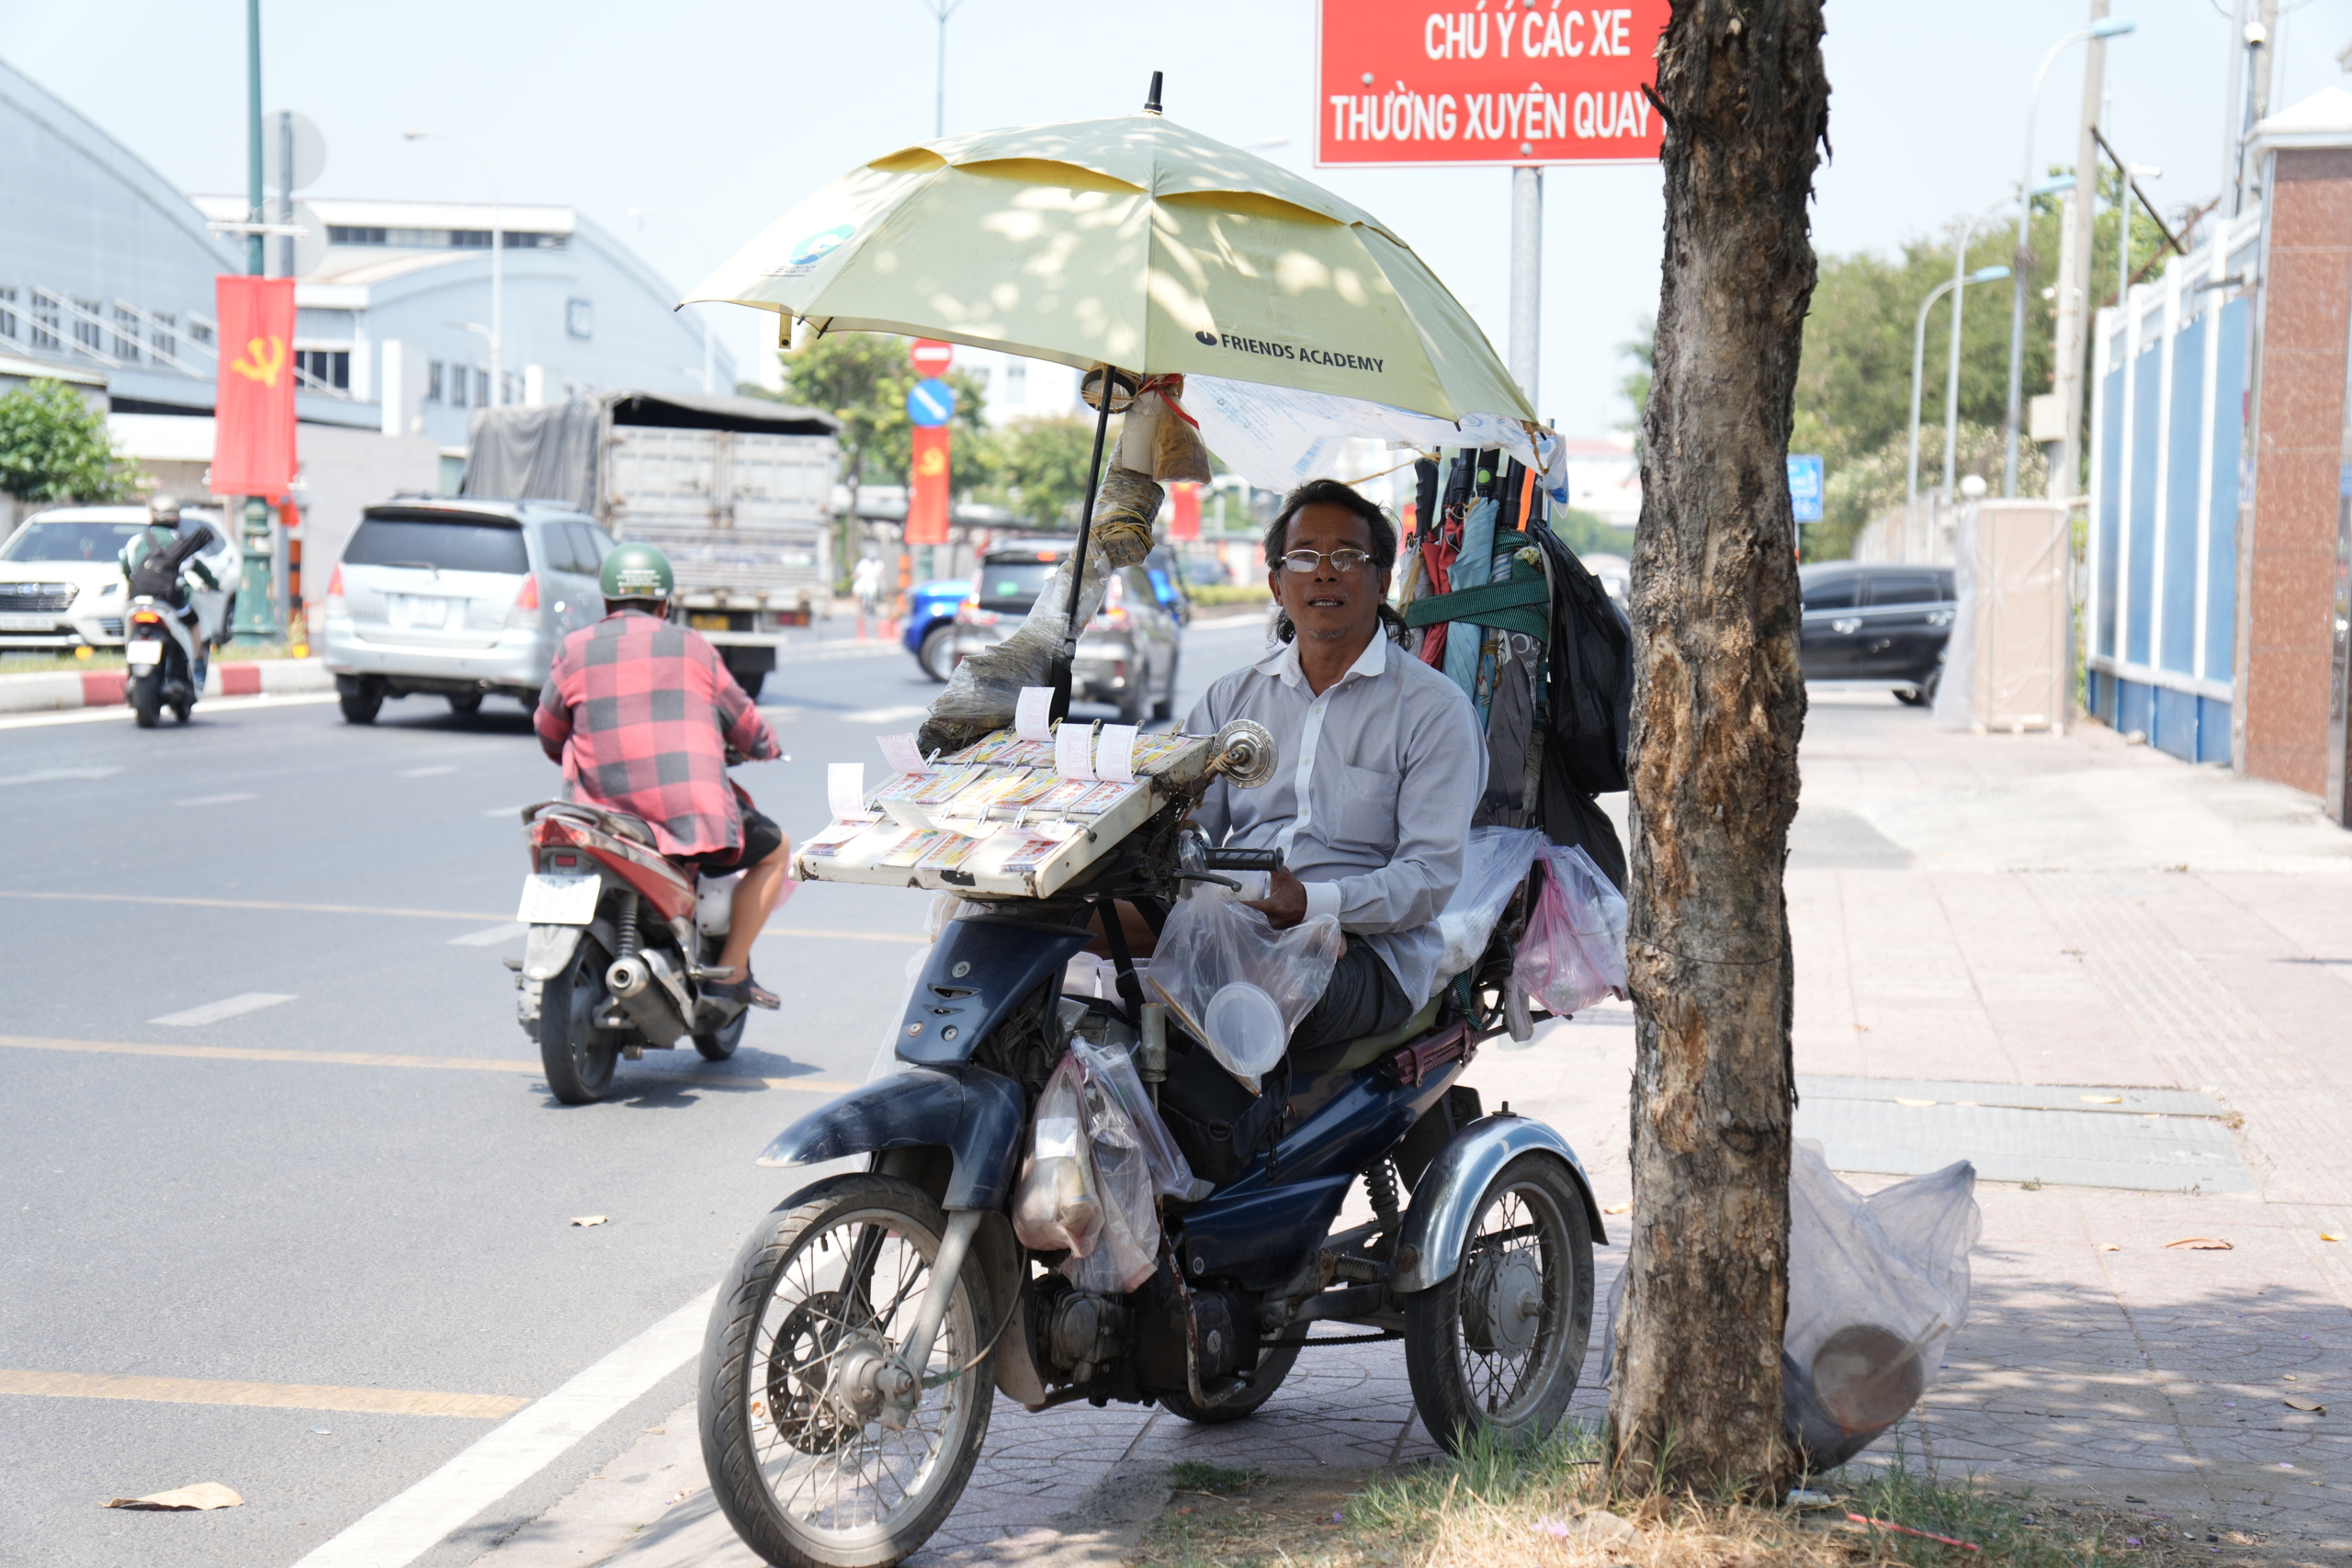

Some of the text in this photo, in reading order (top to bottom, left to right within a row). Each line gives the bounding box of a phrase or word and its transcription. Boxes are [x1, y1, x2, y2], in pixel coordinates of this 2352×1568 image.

[1425, 0, 1632, 60] CHÚ Ý CÁC XE
[1329, 81, 1651, 141] THƯỜNG XUYÊN QUAY
[1221, 333, 1384, 373] FRIENDS ACADEMY
